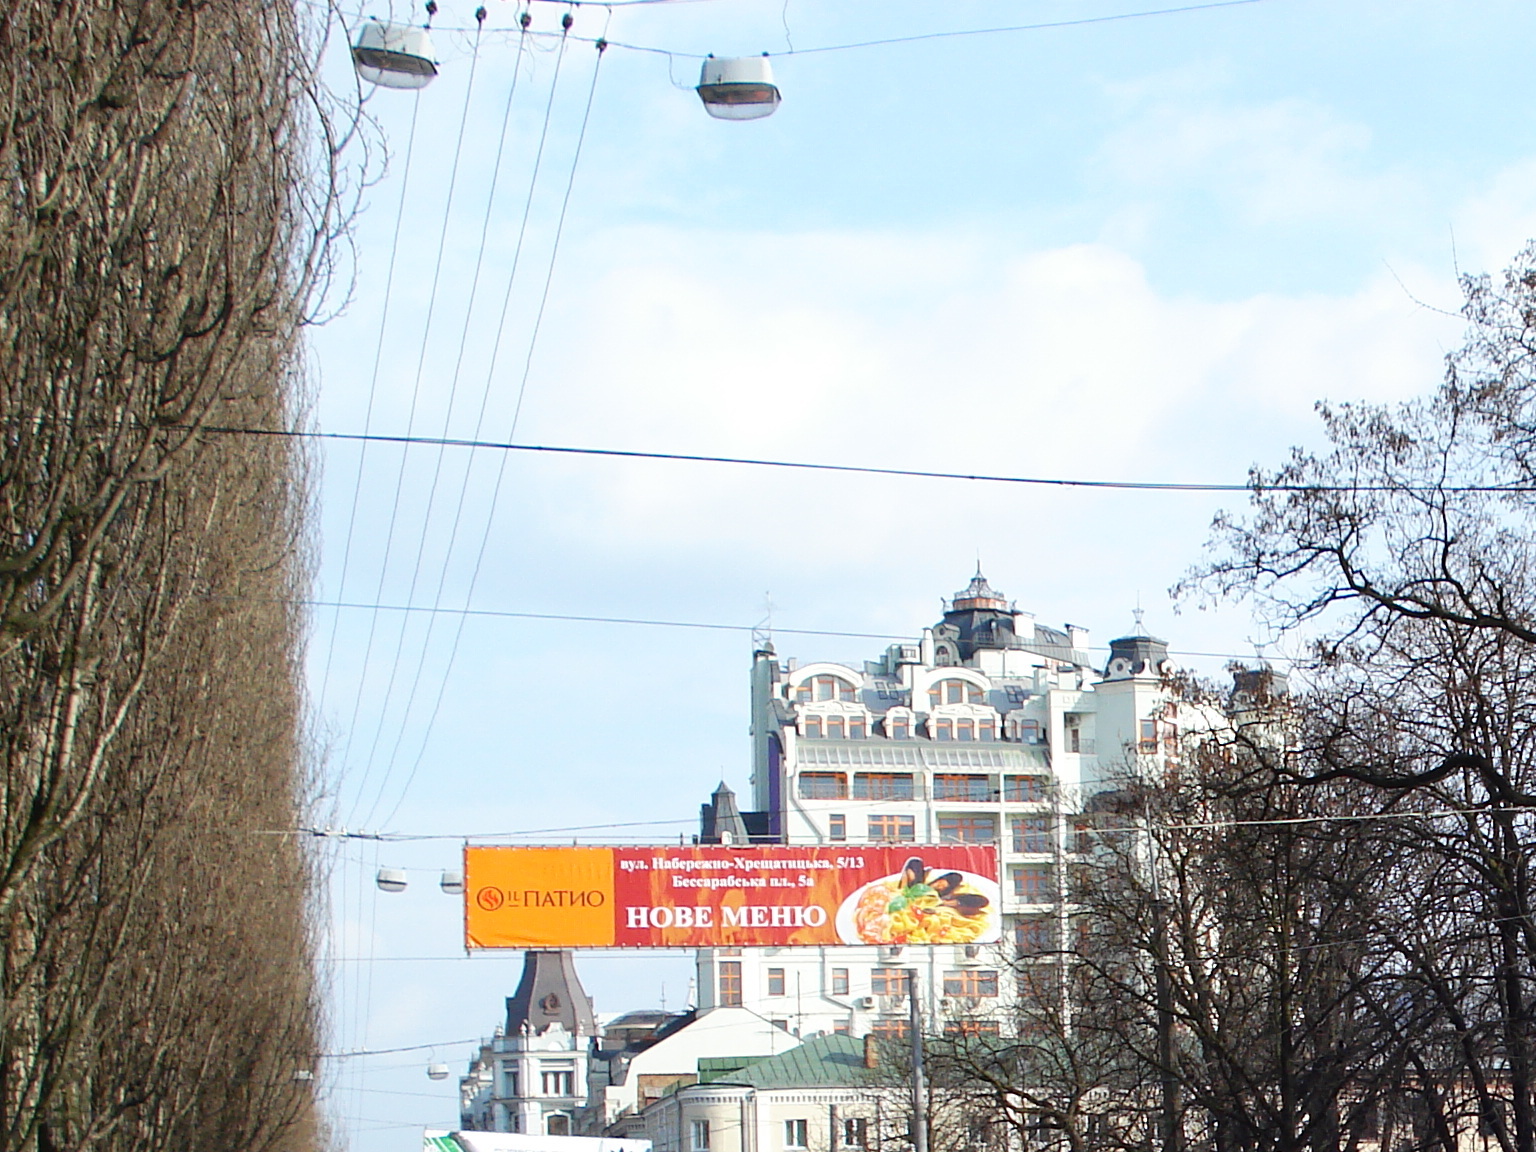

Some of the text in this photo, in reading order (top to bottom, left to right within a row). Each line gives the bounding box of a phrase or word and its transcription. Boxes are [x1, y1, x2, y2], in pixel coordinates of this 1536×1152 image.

[620, 860, 648, 871] вул.
[836, 857, 864, 869] 5/13
[672, 876, 766, 890] Бессарабська
[797, 875, 814, 887] 5а
[523, 890, 605, 908] ПАТИО
[626, 905, 827, 928] НОВЕ МЕНЮ
